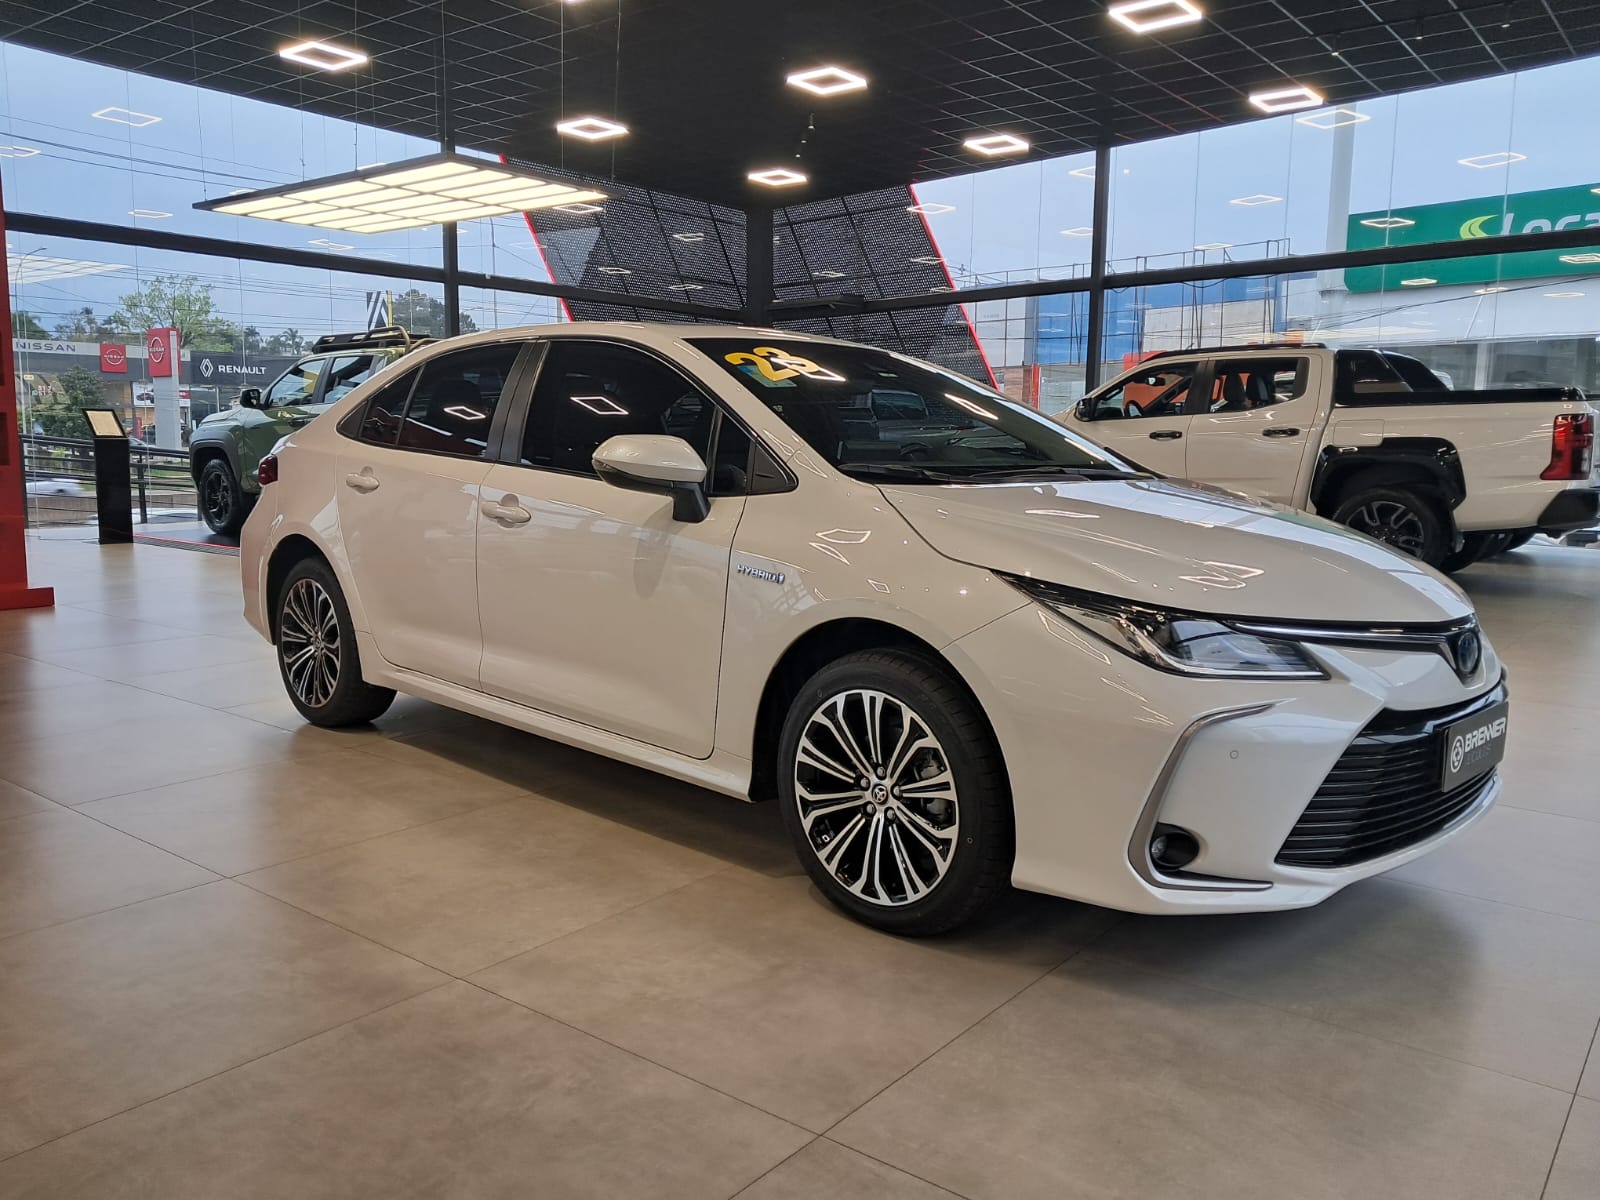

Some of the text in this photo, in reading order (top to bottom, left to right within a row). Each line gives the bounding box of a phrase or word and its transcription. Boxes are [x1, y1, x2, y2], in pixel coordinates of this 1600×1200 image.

[15, 342, 76, 352] NISSAN
[218, 364, 266, 375] RENAULT
[724, 346, 820, 382] 23
[737, 564, 777, 583] HYBRID
